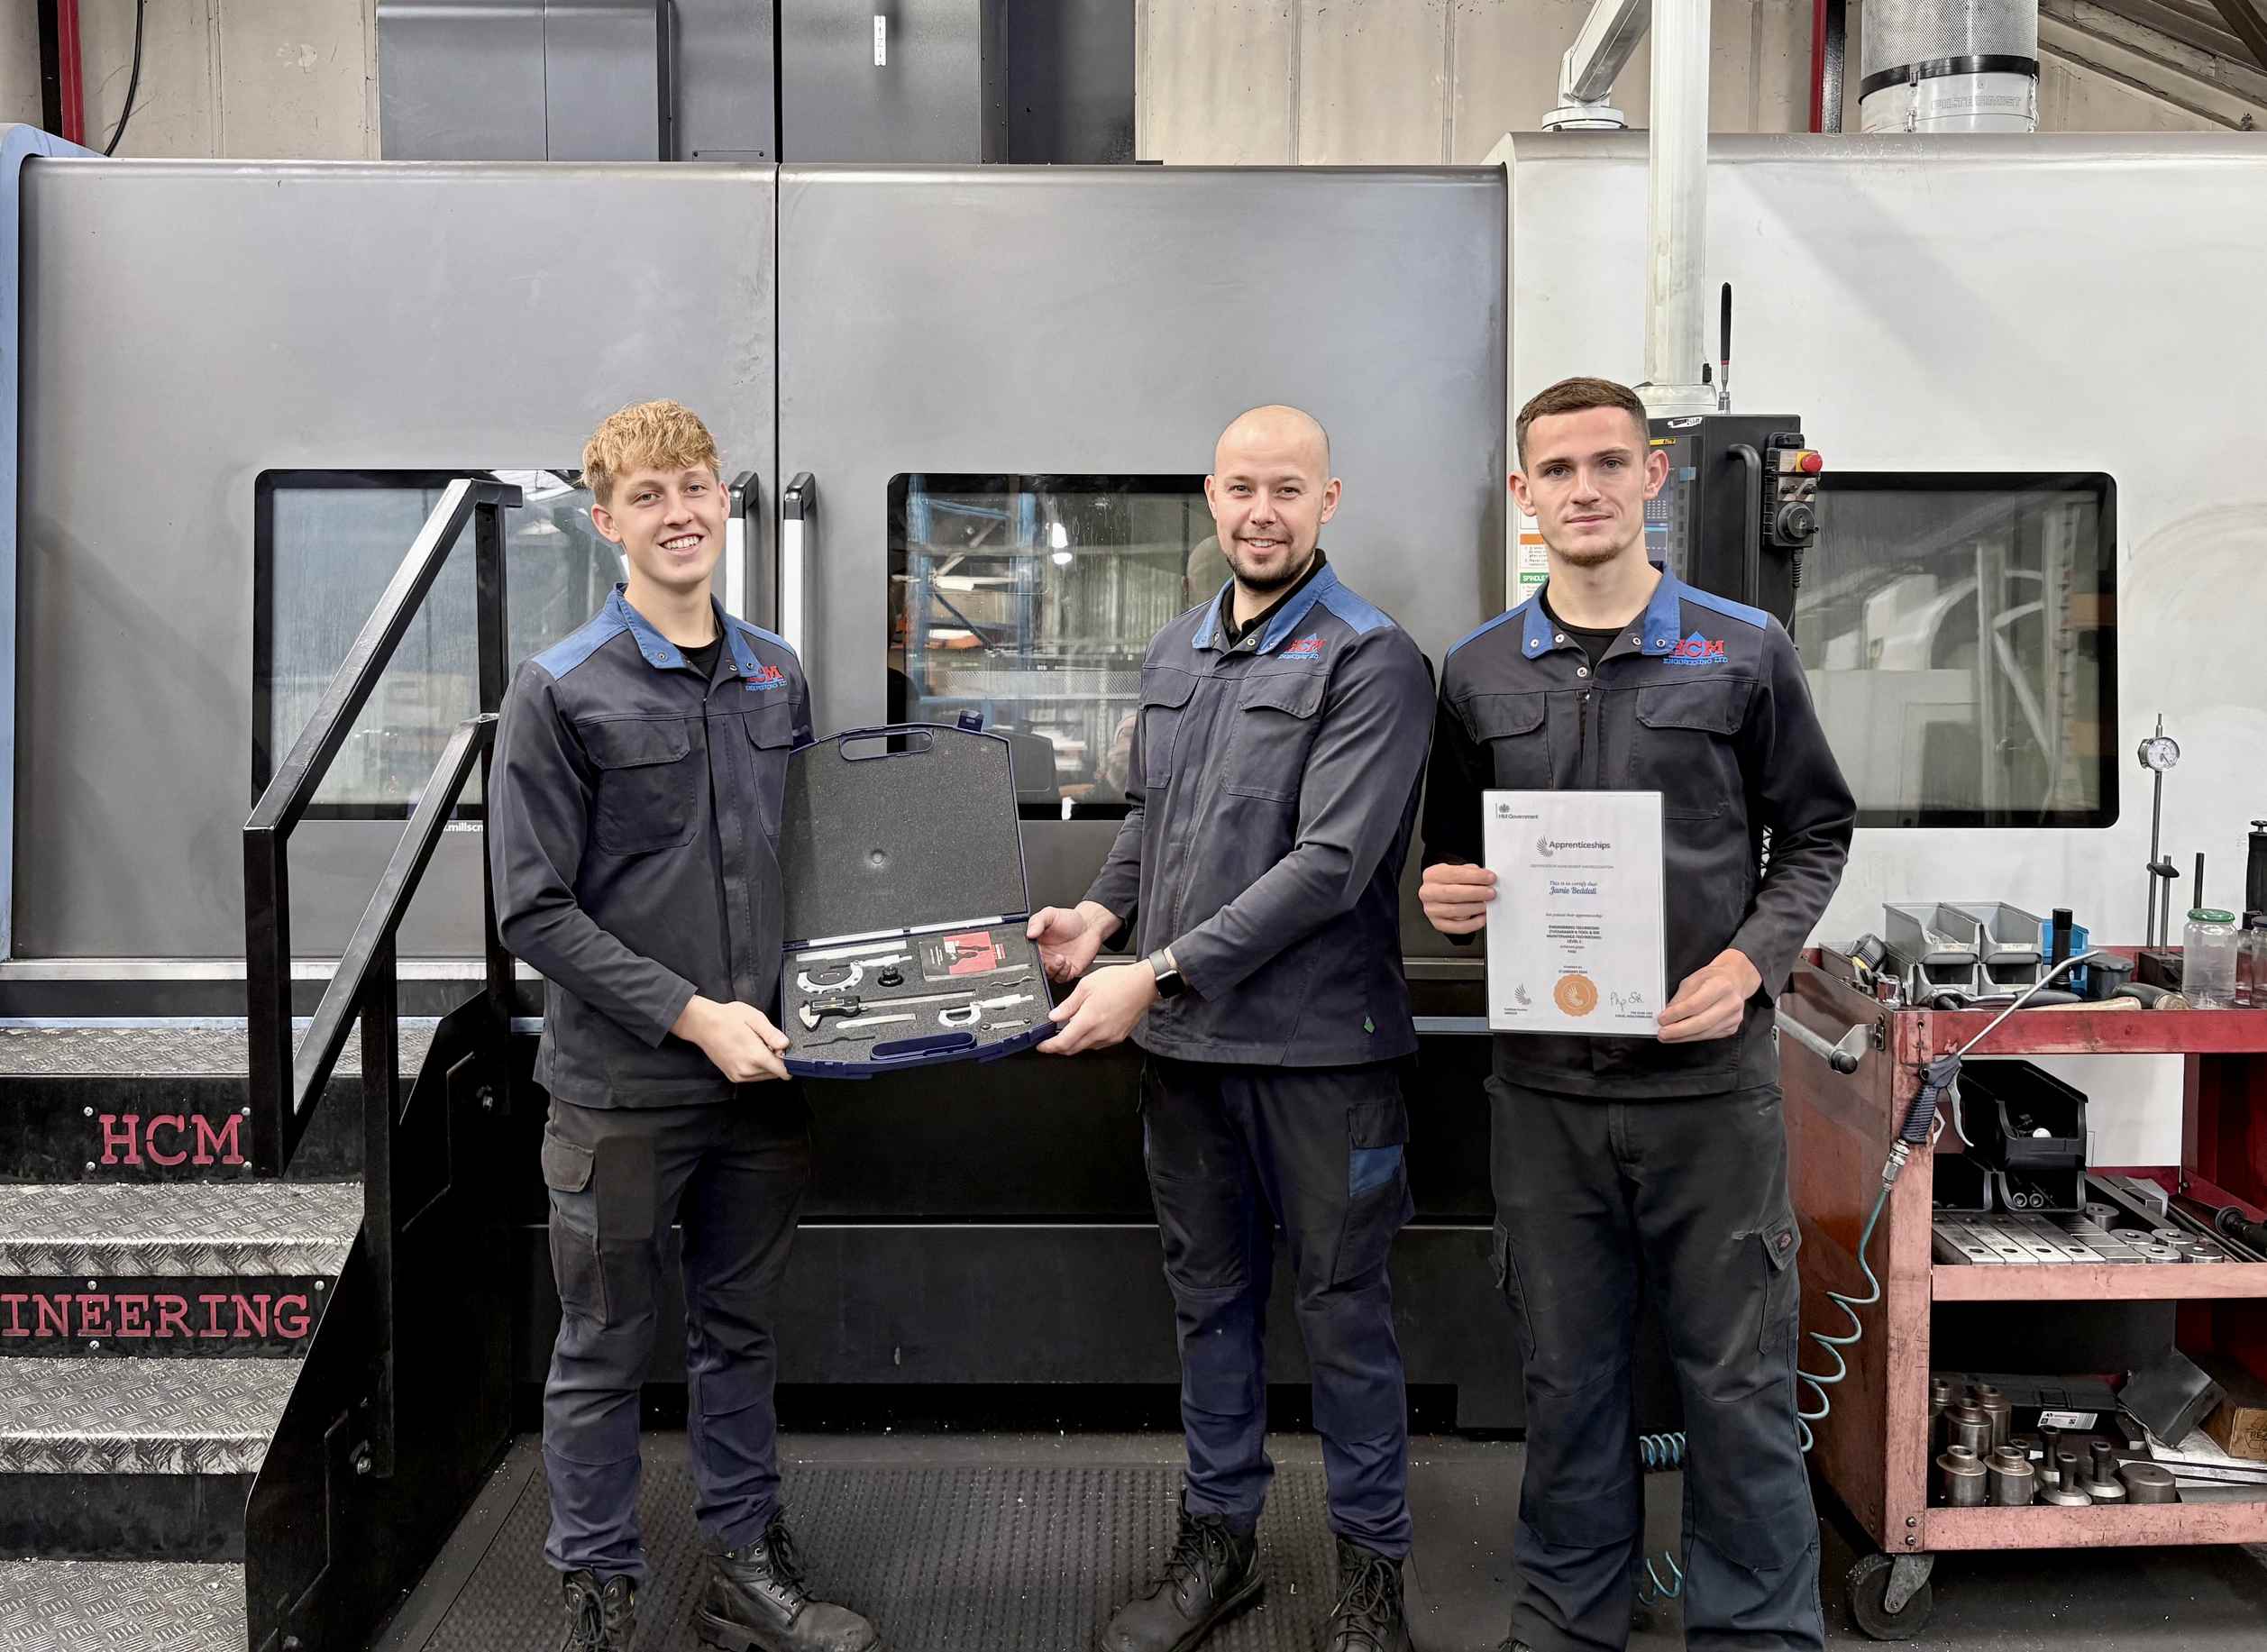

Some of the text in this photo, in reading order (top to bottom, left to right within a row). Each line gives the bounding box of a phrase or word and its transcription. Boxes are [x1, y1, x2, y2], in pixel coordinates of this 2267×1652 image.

[1549, 841, 1611, 850] Apprenticeships
[1549, 887, 1570, 895] Jamie
[98, 1114, 244, 1166] HCM
[1, 1293, 311, 1338] INEERING
